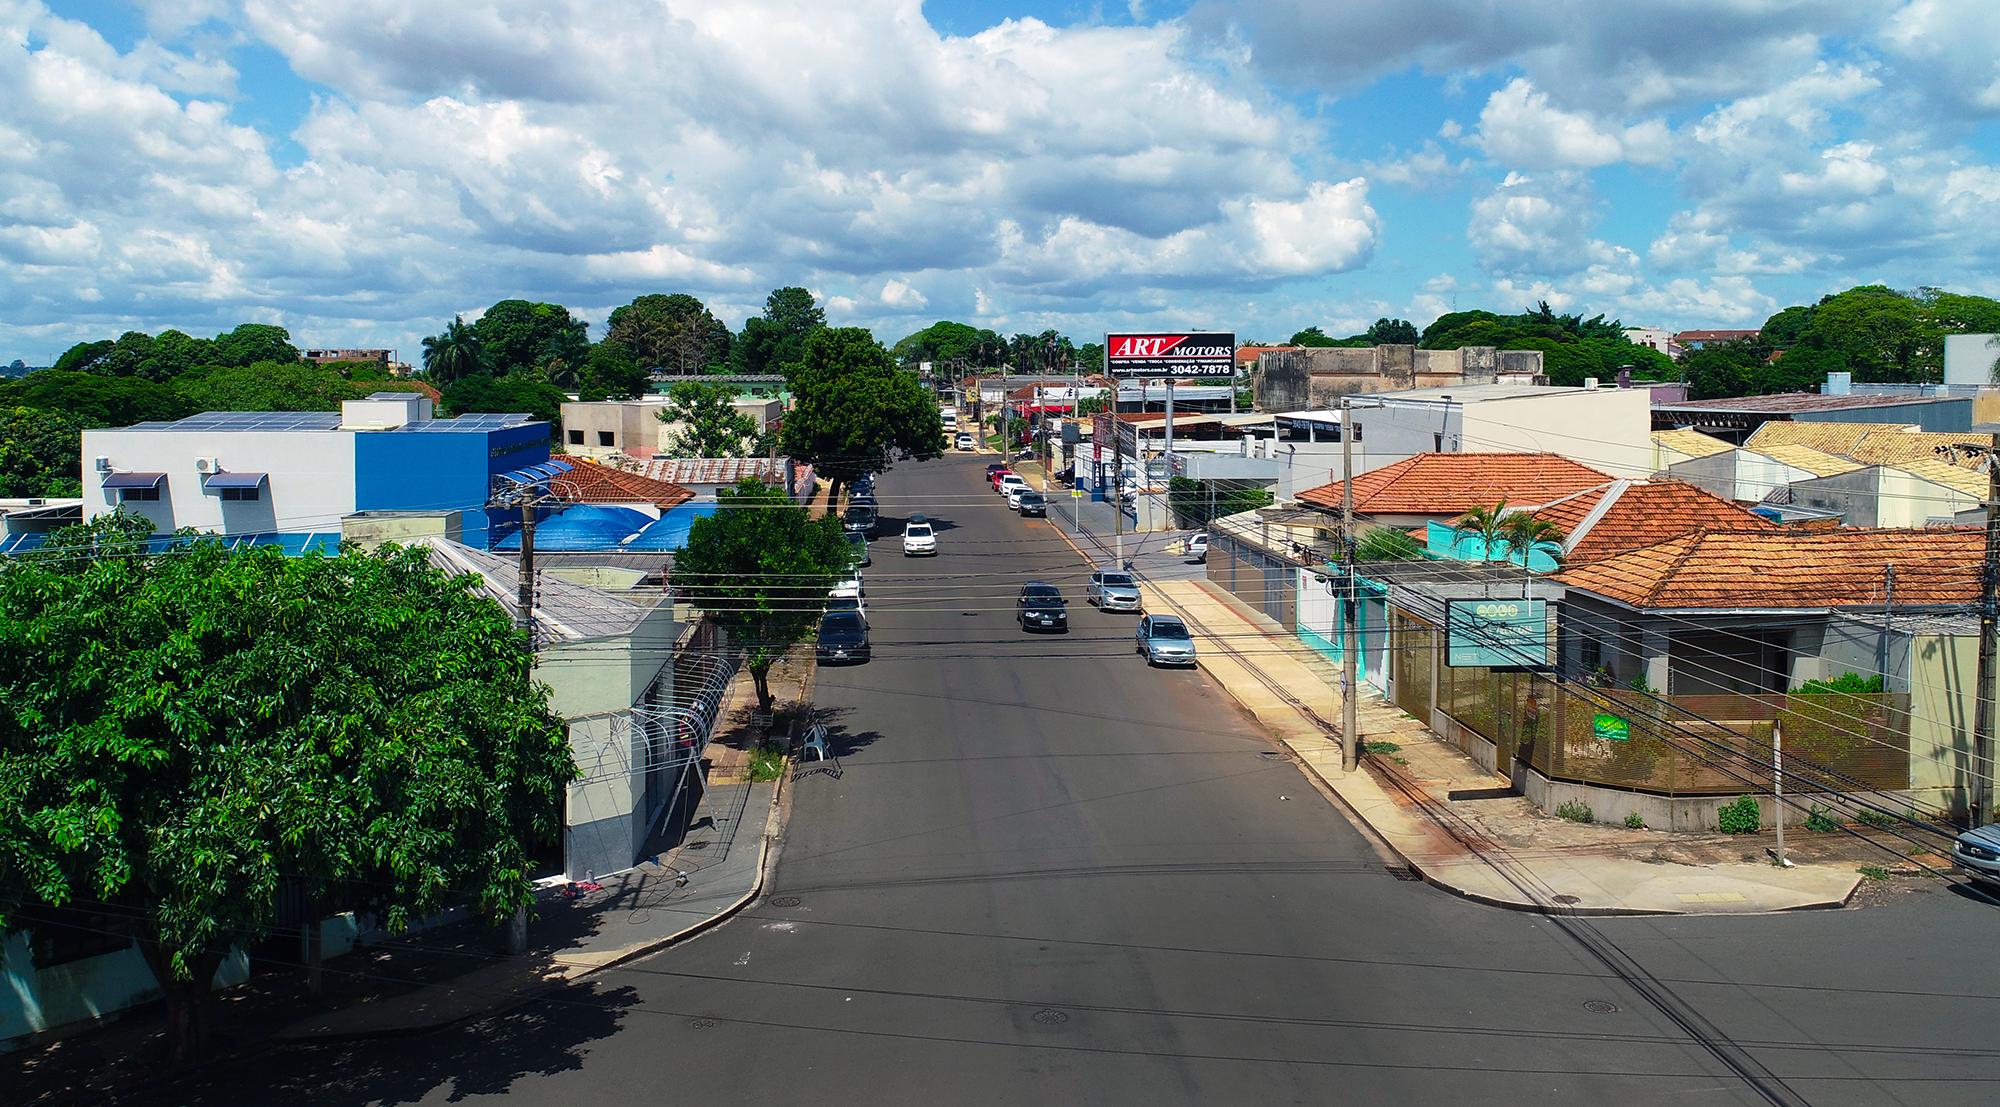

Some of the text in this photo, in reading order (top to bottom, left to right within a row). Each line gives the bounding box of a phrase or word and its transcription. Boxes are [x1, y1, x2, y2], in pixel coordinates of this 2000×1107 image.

[1115, 338, 1232, 356] ART MOTORS
[1170, 365, 1230, 374] 3042-7878
